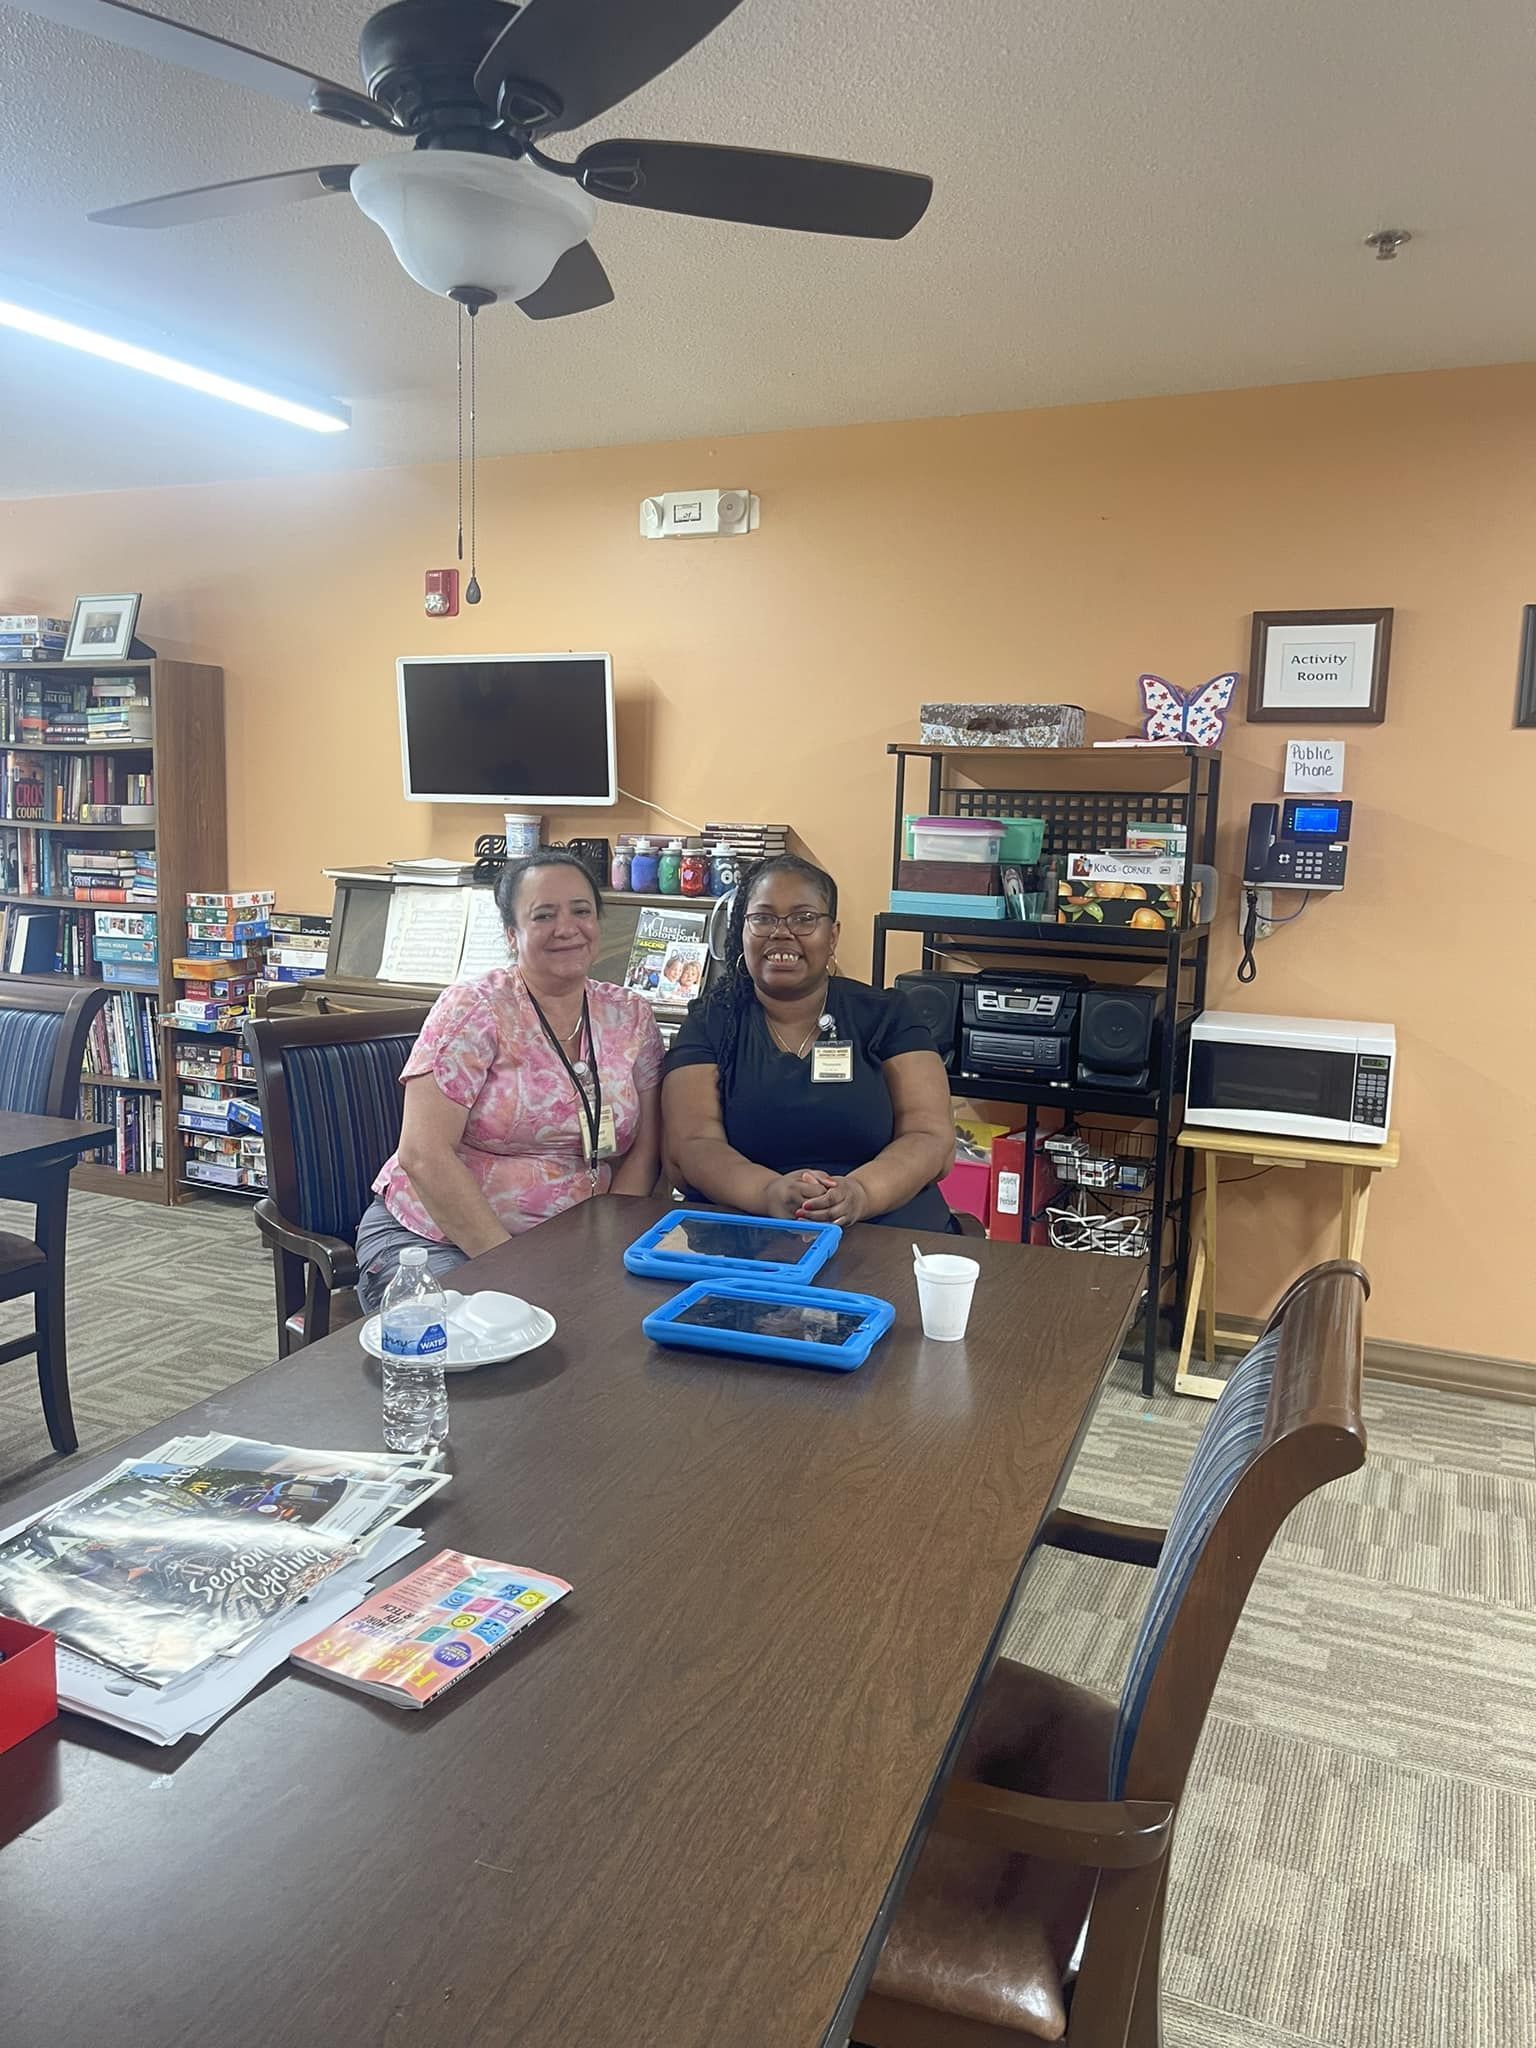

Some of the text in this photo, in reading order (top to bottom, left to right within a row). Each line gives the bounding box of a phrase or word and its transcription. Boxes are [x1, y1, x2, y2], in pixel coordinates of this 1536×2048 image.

[1290, 653, 1348, 666] Activity
[1297, 671, 1338, 682] Room
[1291, 744, 1334, 761] Public
[1293, 762, 1334, 777] Phone
[16, 807, 45, 819] COUNT
[1094, 863, 1153, 875] KINGS CORNER
[639, 922, 703, 943] Motorsports
[189, 1546, 272, 1604] Season
[241, 1545, 331, 1599] Cycling
[380, 1604, 404, 1617] TECH
[363, 1615, 389, 1629] MORE
